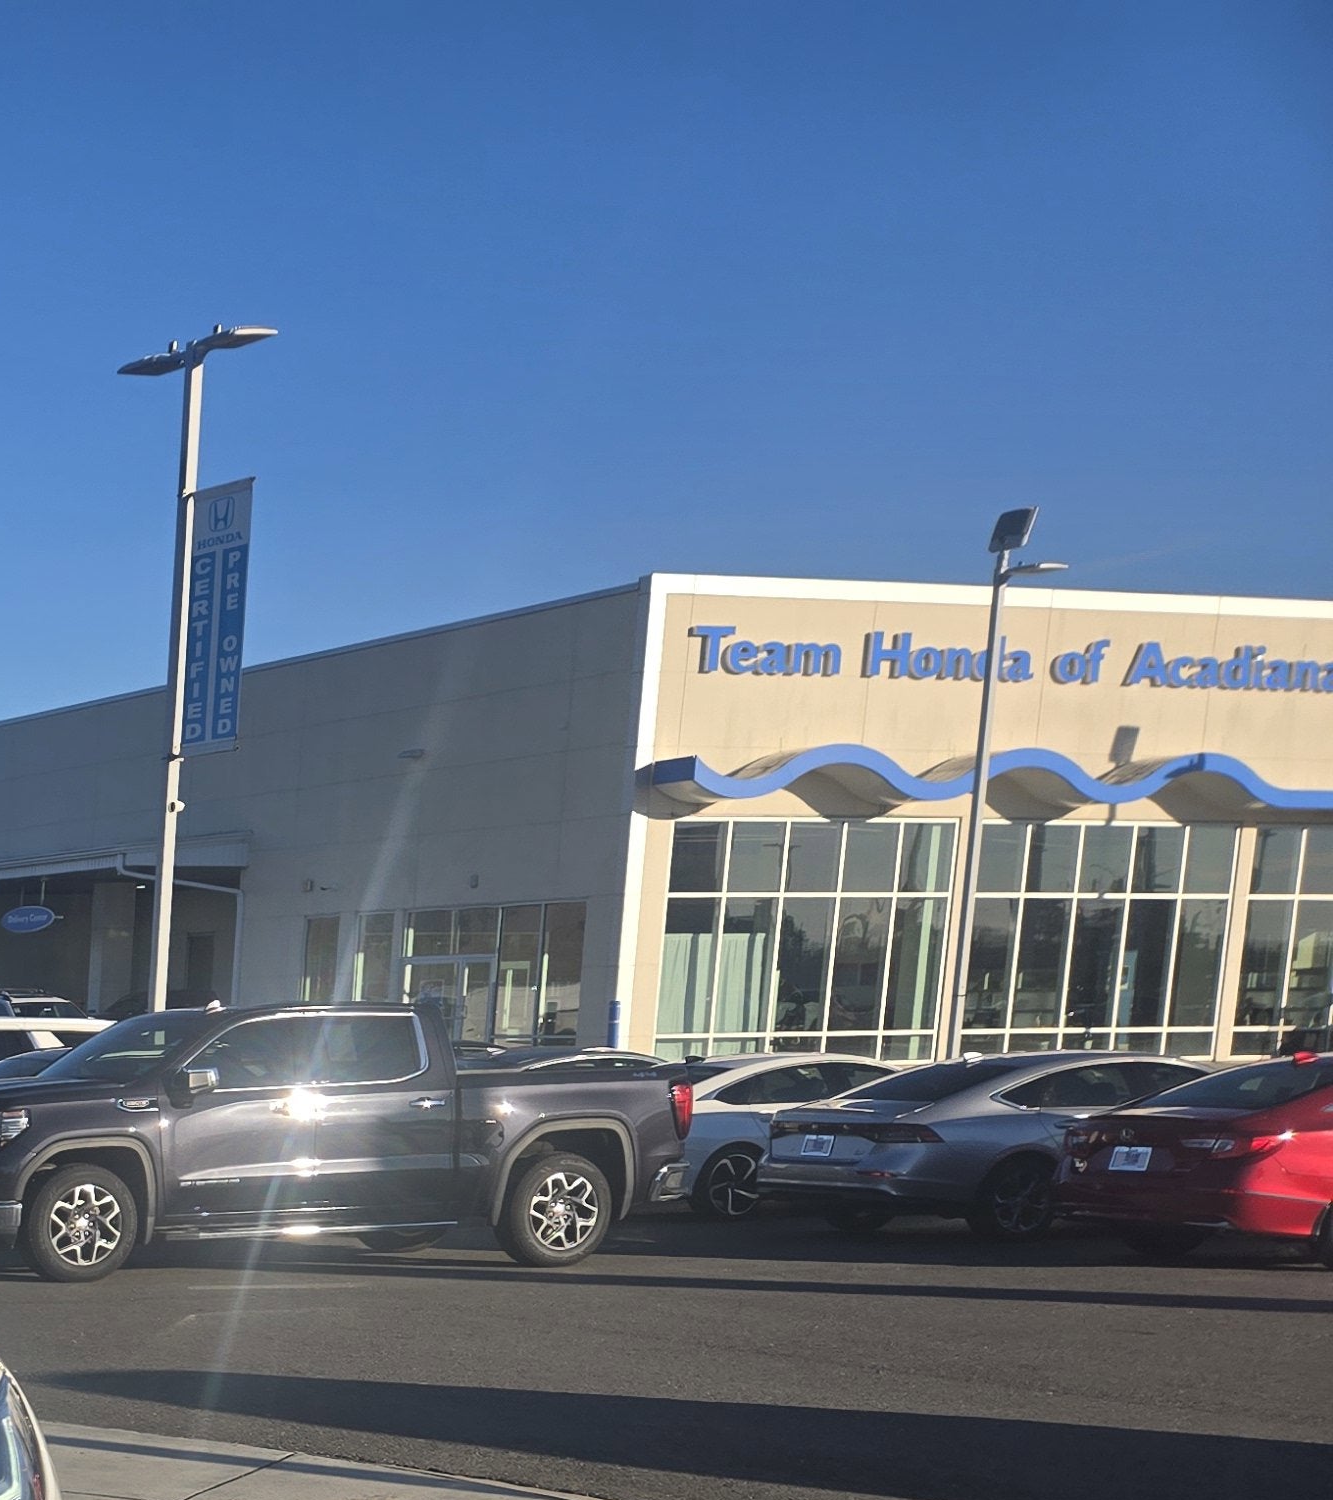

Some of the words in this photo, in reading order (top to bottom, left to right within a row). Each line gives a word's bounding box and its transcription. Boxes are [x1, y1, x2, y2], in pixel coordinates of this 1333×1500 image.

[196, 531, 243, 550] HONDA
[226, 551, 241, 612] PRE
[185, 558, 213, 740] CERTIFIED
[688, 625, 842, 676] Team
[860, 631, 1033, 681] Honda
[1050, 638, 1111, 685] of
[1121, 641, 1333, 693] Acadiana
[217, 635, 238, 735] OWNED
